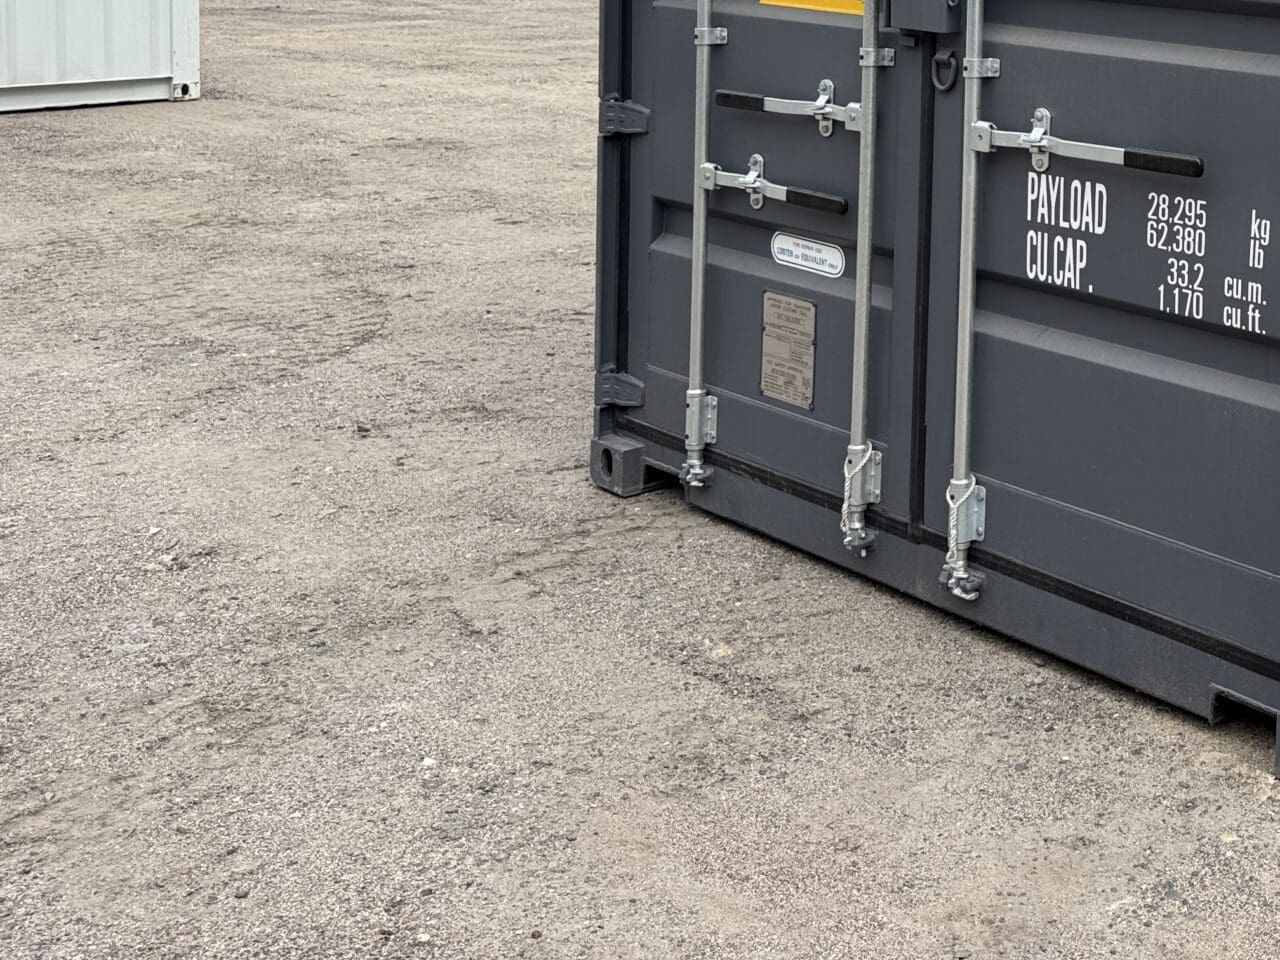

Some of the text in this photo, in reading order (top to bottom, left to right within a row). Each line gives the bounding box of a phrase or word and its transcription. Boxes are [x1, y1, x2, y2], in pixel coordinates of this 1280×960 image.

[1026, 171, 1271, 245] PAYLOAD 28,295 kg
[1026, 230, 1267, 305] CU.CAP. 33.2 cu.m.
[1146, 221, 1264, 269] 62,380 lb
[1223, 304, 1266, 334] cu.ft.
